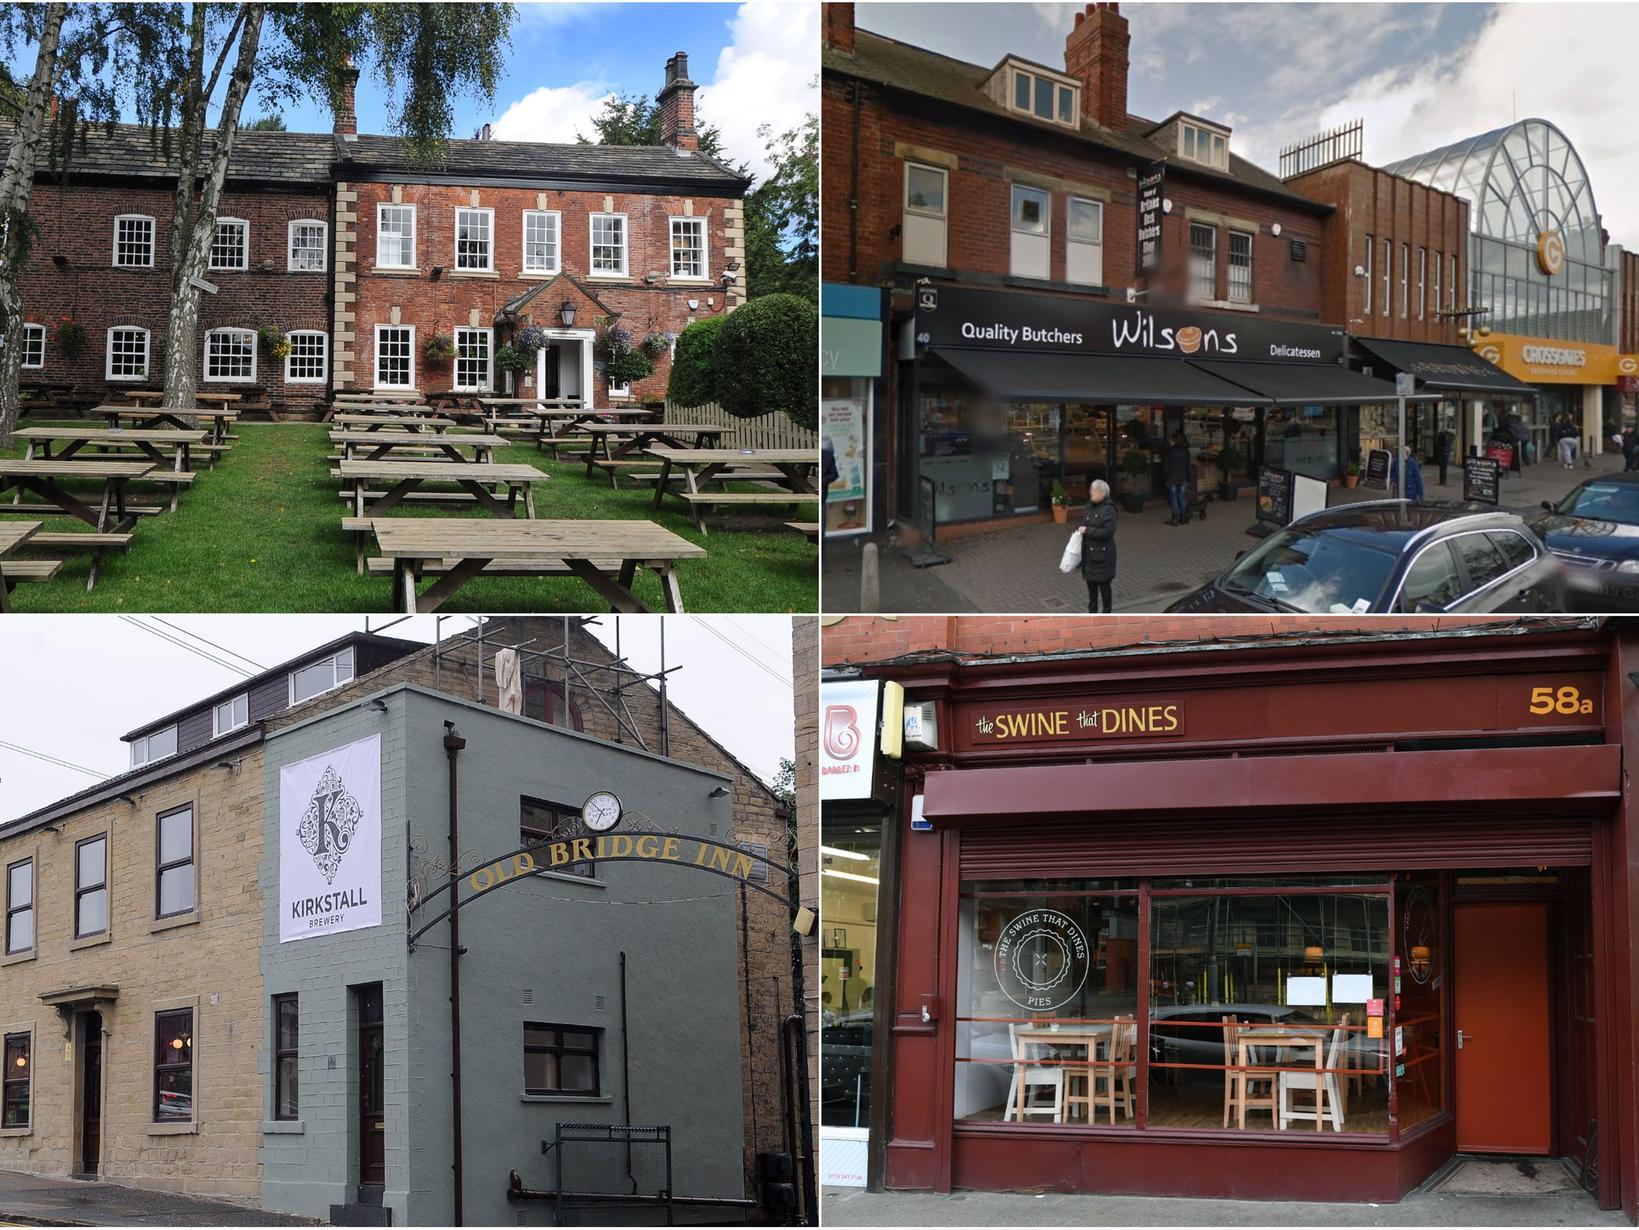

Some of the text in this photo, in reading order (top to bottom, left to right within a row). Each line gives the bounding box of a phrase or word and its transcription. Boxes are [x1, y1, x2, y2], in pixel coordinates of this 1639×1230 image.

[917, 332, 930, 343] 40
[961, 322, 1083, 345] Quality Butchers
[1112, 311, 1237, 354] Wilsons
[1270, 344, 1321, 358] Delicatessen
[1522, 344, 1586, 367] CROSSGATES
[1529, 686, 1593, 715] 58a
[976, 705, 1178, 739] the SWINE that DINES
[469, 851, 535, 893] OLD
[548, 834, 682, 867] BRIDGE
[696, 843, 758, 881] INN
[292, 887, 368, 919] KIRKSTALL
[309, 914, 345, 928] BREWERY
[999, 914, 1085, 959] THE SWINE THAT DINES
[1028, 996, 1052, 1007] PIES
